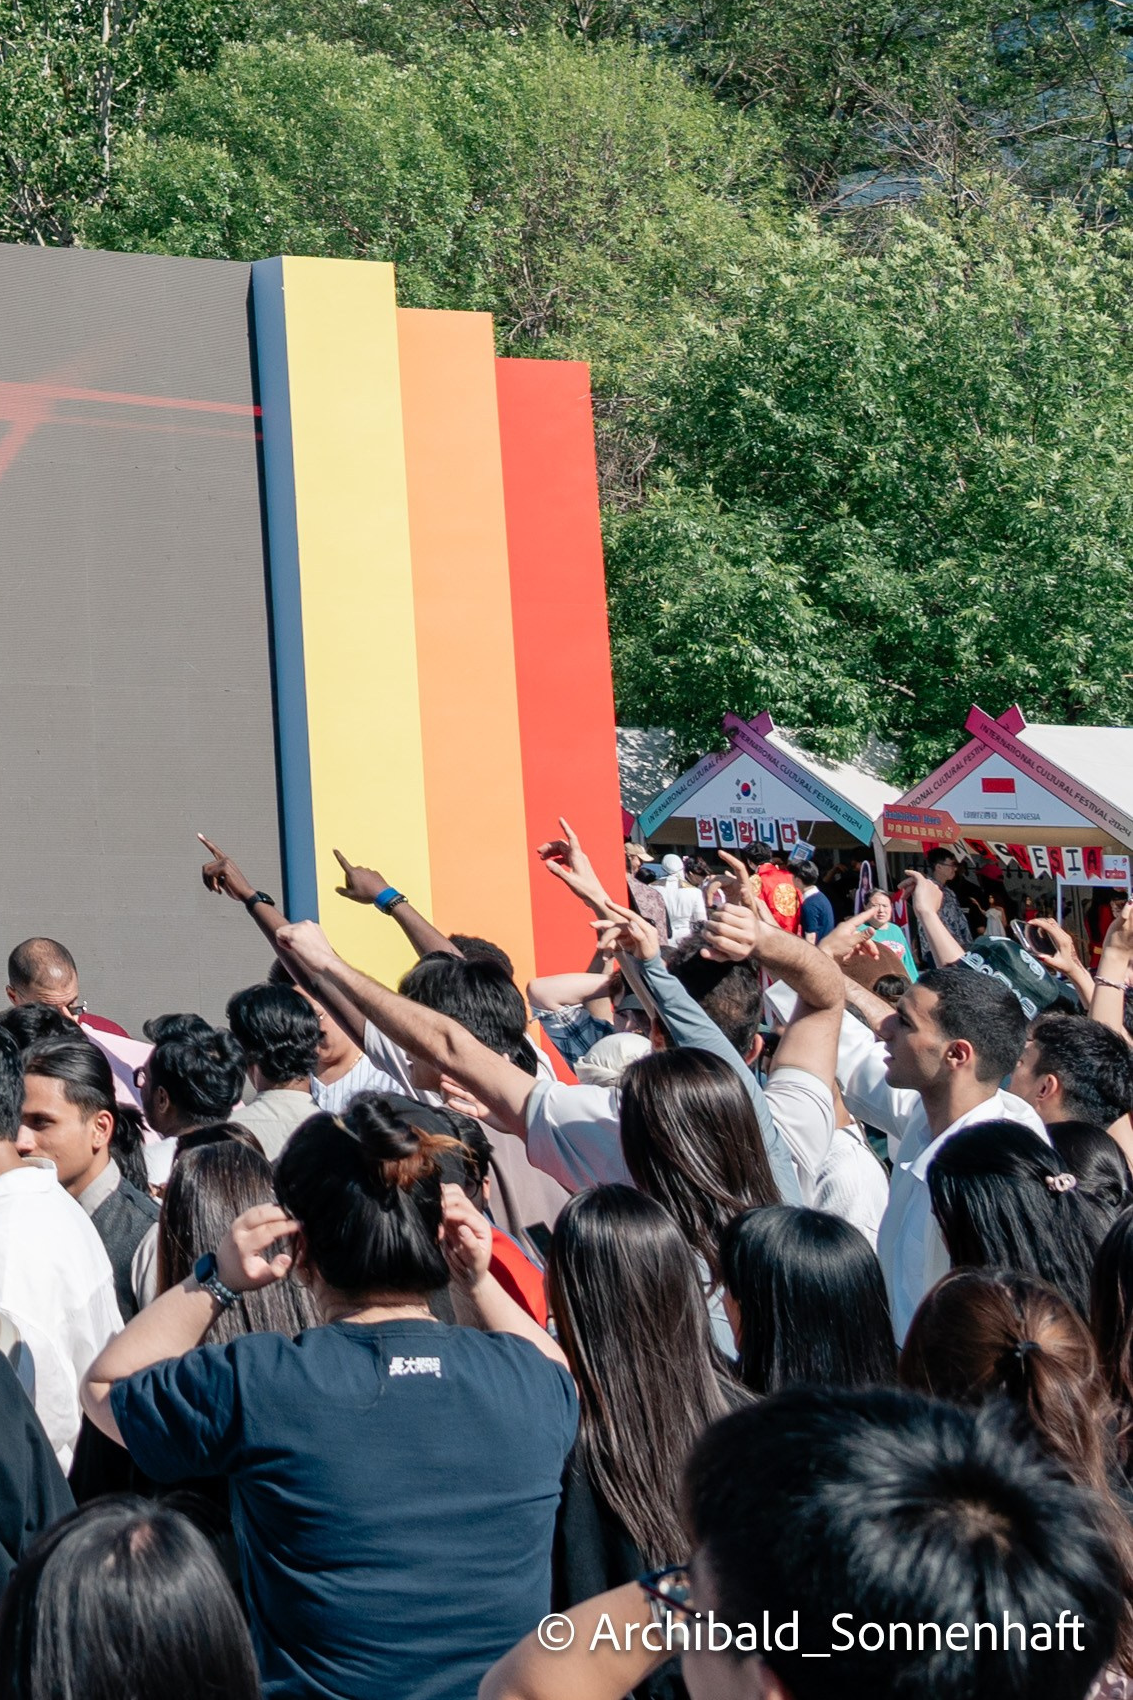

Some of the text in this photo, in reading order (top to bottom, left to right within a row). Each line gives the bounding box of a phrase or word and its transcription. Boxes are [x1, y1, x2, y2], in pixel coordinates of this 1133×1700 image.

[932, 761, 964, 790] CULTURAL
[979, 723, 1132, 838] INTERNATIONAL CULTURAL FESTIVAL 2024
[648, 785, 688, 824] INTERNATIONAL
[687, 761, 716, 788] CULTURAL
[779, 764, 813, 794] CULTURAL
[812, 789, 842, 816] FESTIVAL
[841, 811, 863, 831] 2024
[746, 807, 766, 815] KOREA
[1002, 812, 1042, 821] INDONESIA
[698, 819, 797, 845] 환영합니다
